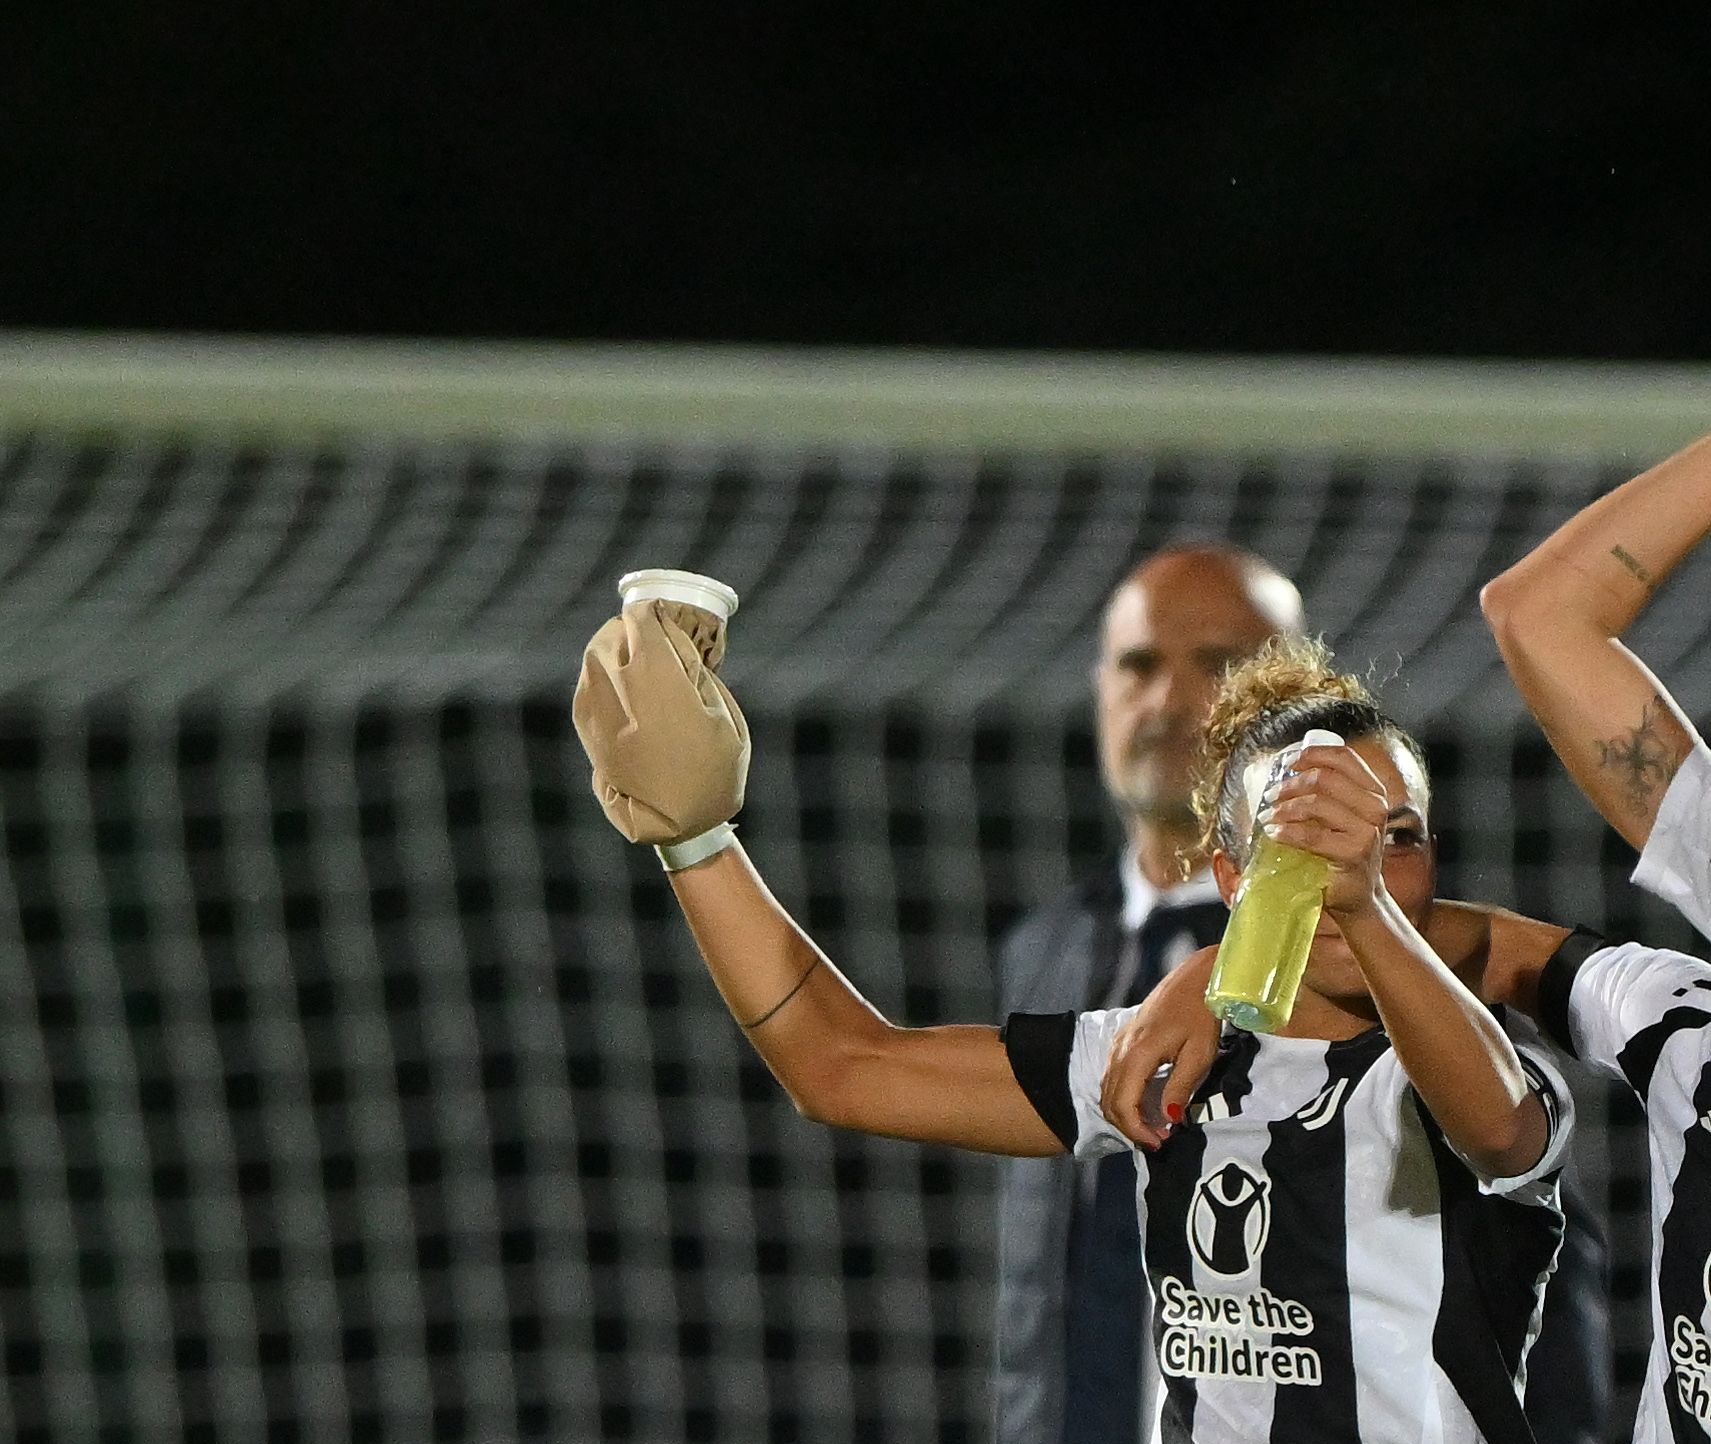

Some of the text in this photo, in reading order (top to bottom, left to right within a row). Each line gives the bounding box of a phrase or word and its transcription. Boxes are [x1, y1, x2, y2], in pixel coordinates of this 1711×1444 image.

[1168, 1282, 1309, 1330] Save the
[1166, 1332, 1318, 1380] Children
